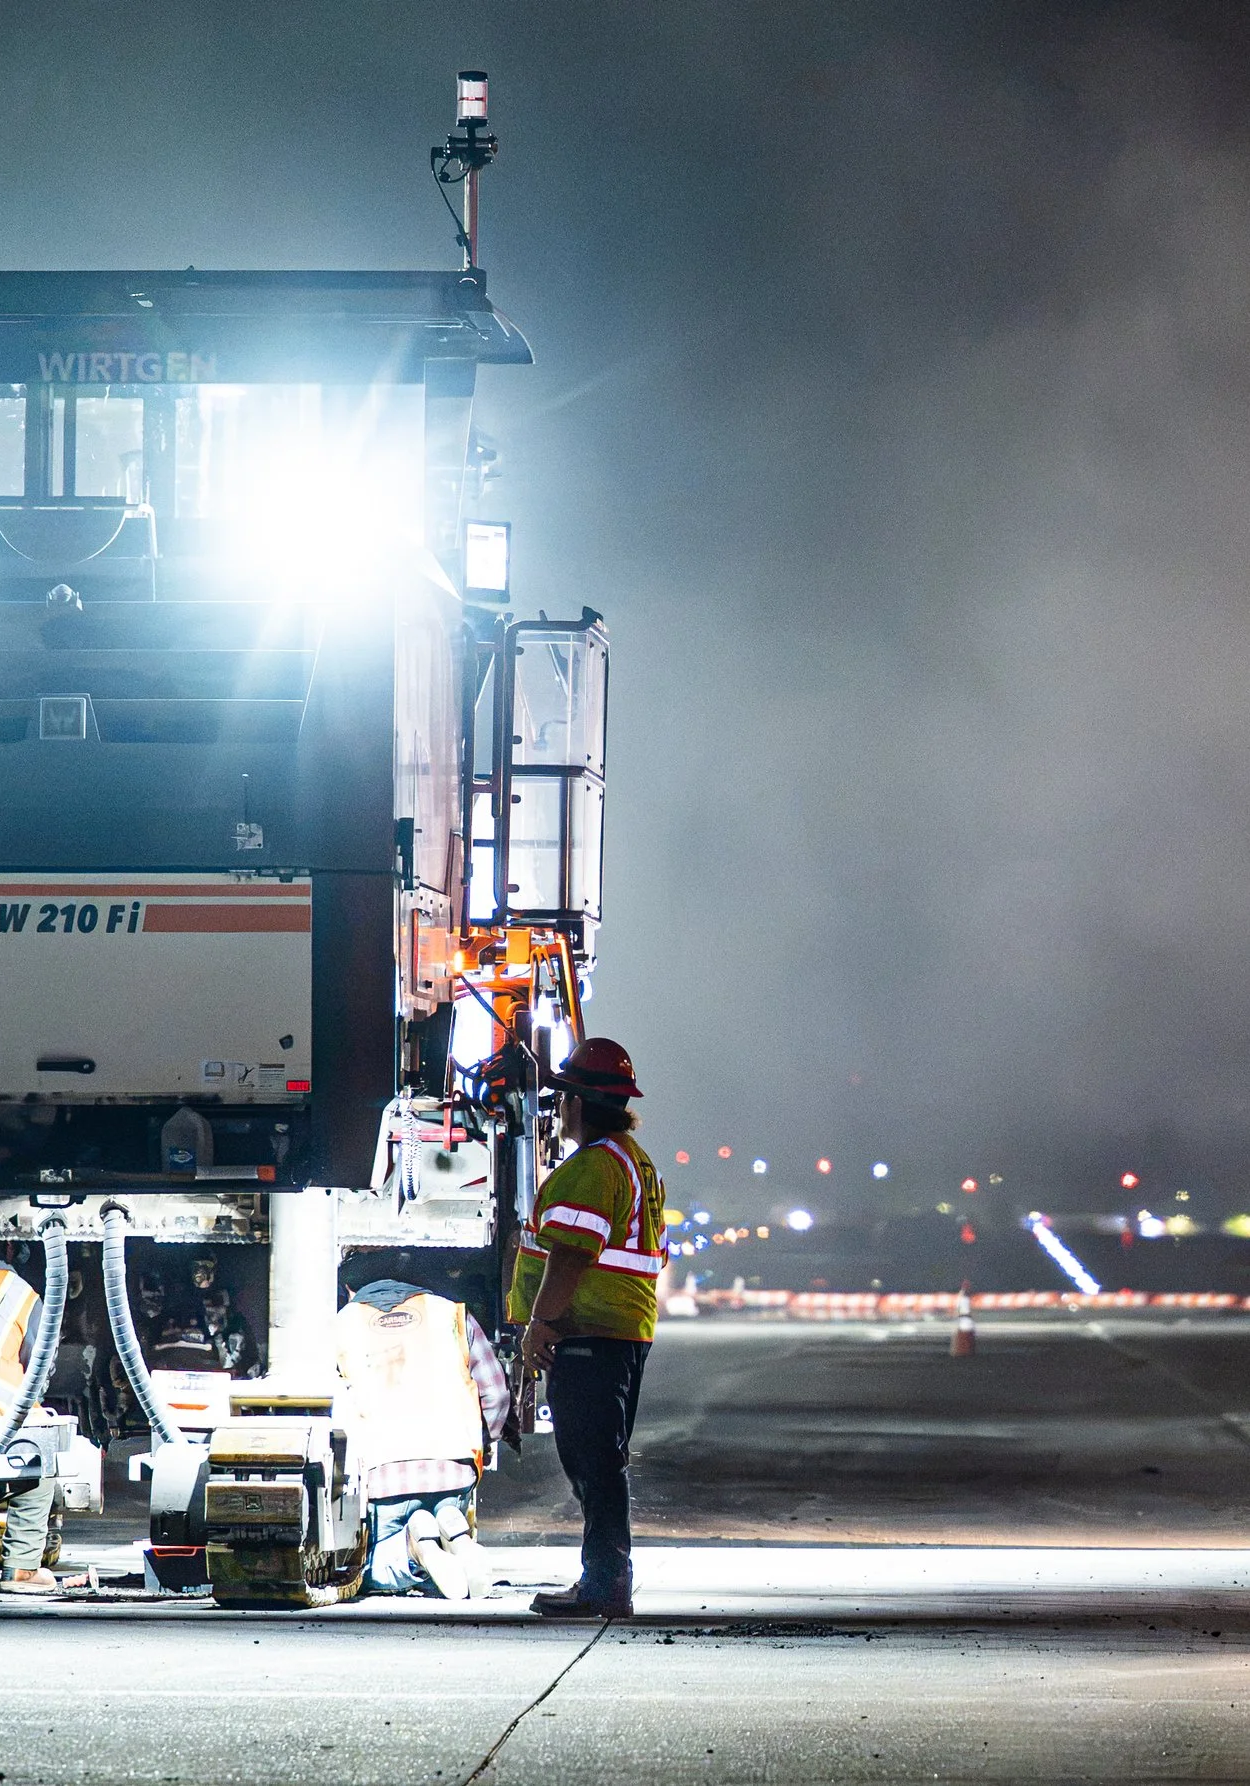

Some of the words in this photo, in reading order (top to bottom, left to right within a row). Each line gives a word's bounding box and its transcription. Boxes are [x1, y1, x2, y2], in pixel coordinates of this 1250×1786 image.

[39, 352, 217, 382] WIRTGEN
[37, 903, 98, 933] 210
[106, 902, 143, 933] Fi
